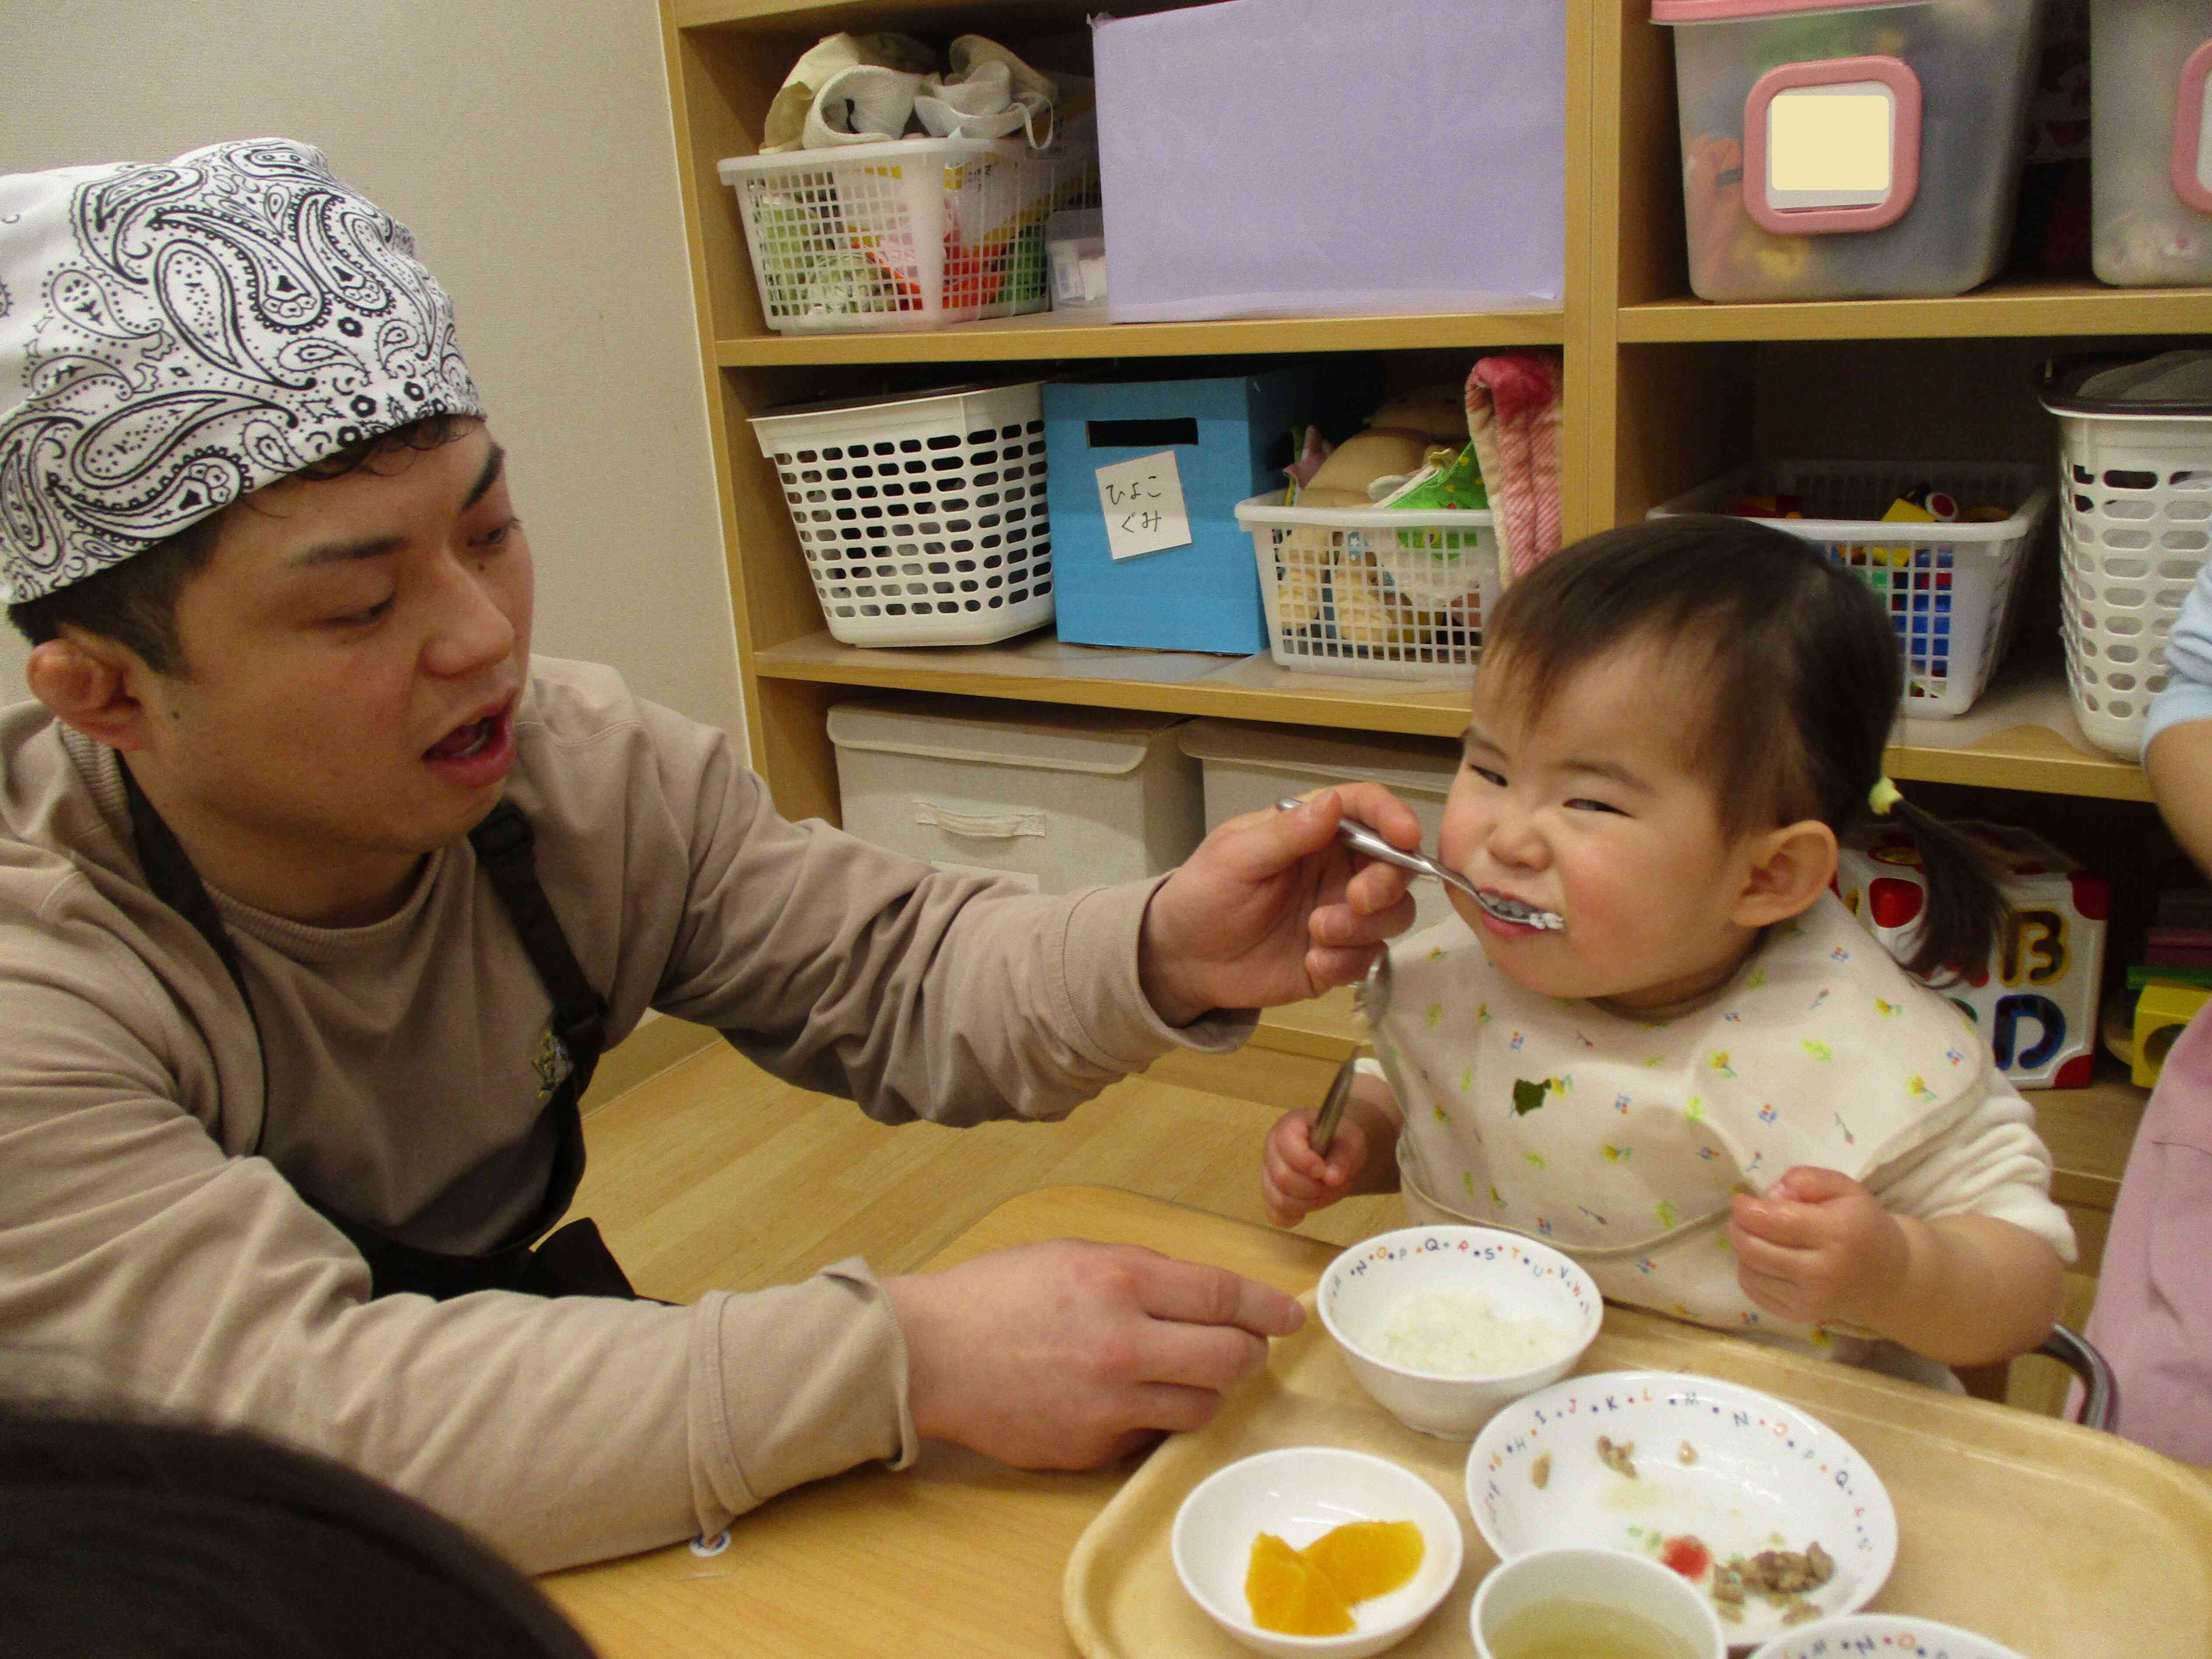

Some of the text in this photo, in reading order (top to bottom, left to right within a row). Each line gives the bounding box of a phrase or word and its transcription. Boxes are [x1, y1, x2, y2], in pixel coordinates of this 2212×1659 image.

[1106, 476, 1162, 505] ひよこ
[1121, 510, 1162, 533] ぐみ
[1998, 907, 2072, 987] B
[1993, 994, 2066, 1071] D
